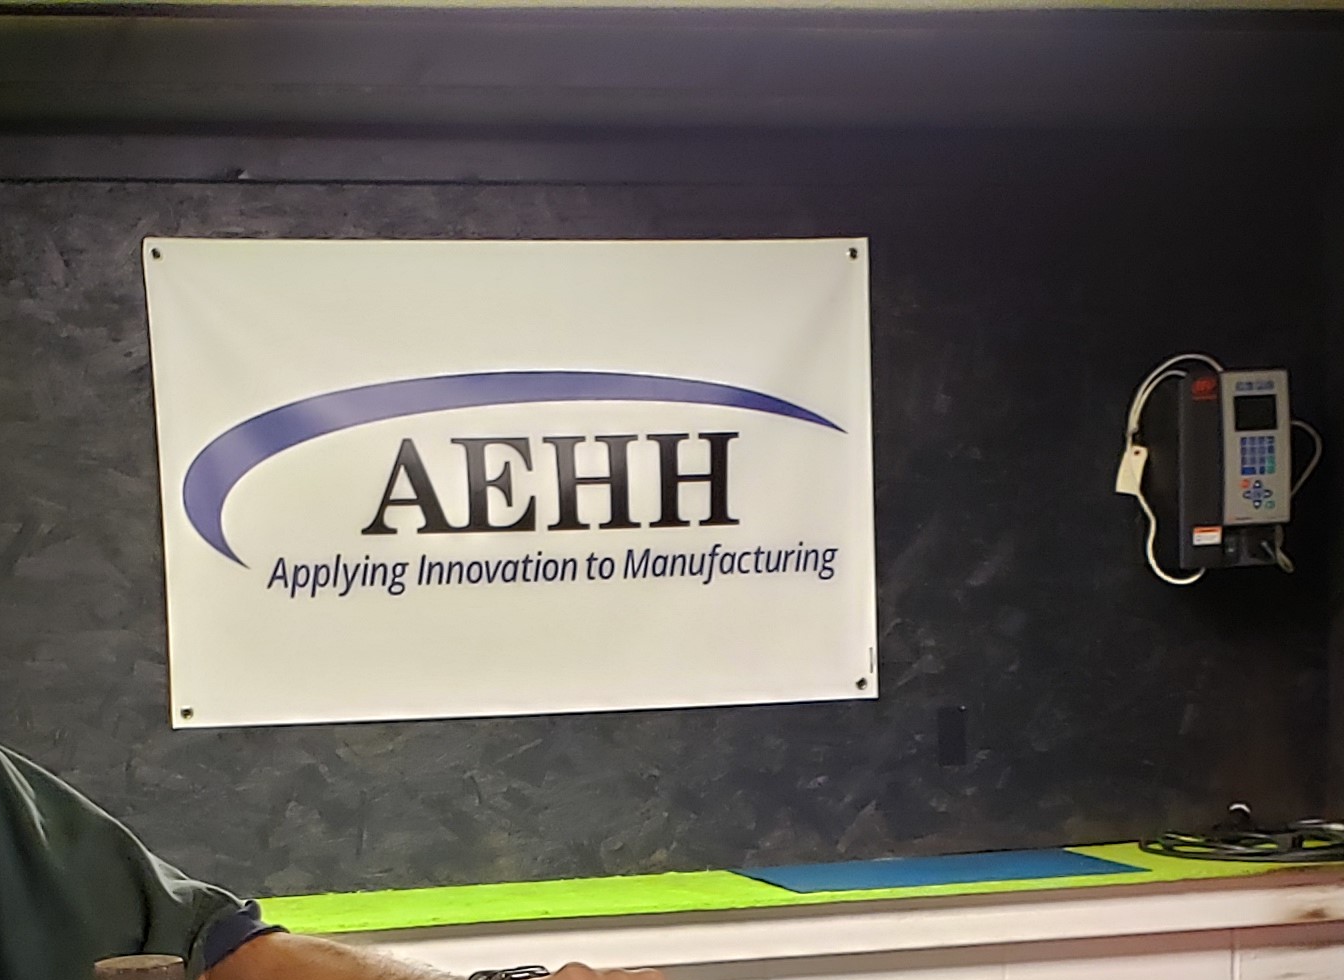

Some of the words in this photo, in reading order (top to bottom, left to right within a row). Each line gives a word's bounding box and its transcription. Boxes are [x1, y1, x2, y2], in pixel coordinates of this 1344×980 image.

[360, 431, 739, 535] AEHH
[266, 553, 409, 598] Applying
[417, 550, 577, 585] Innovation
[585, 552, 615, 580] to
[623, 541, 838, 584] Manufacturing
